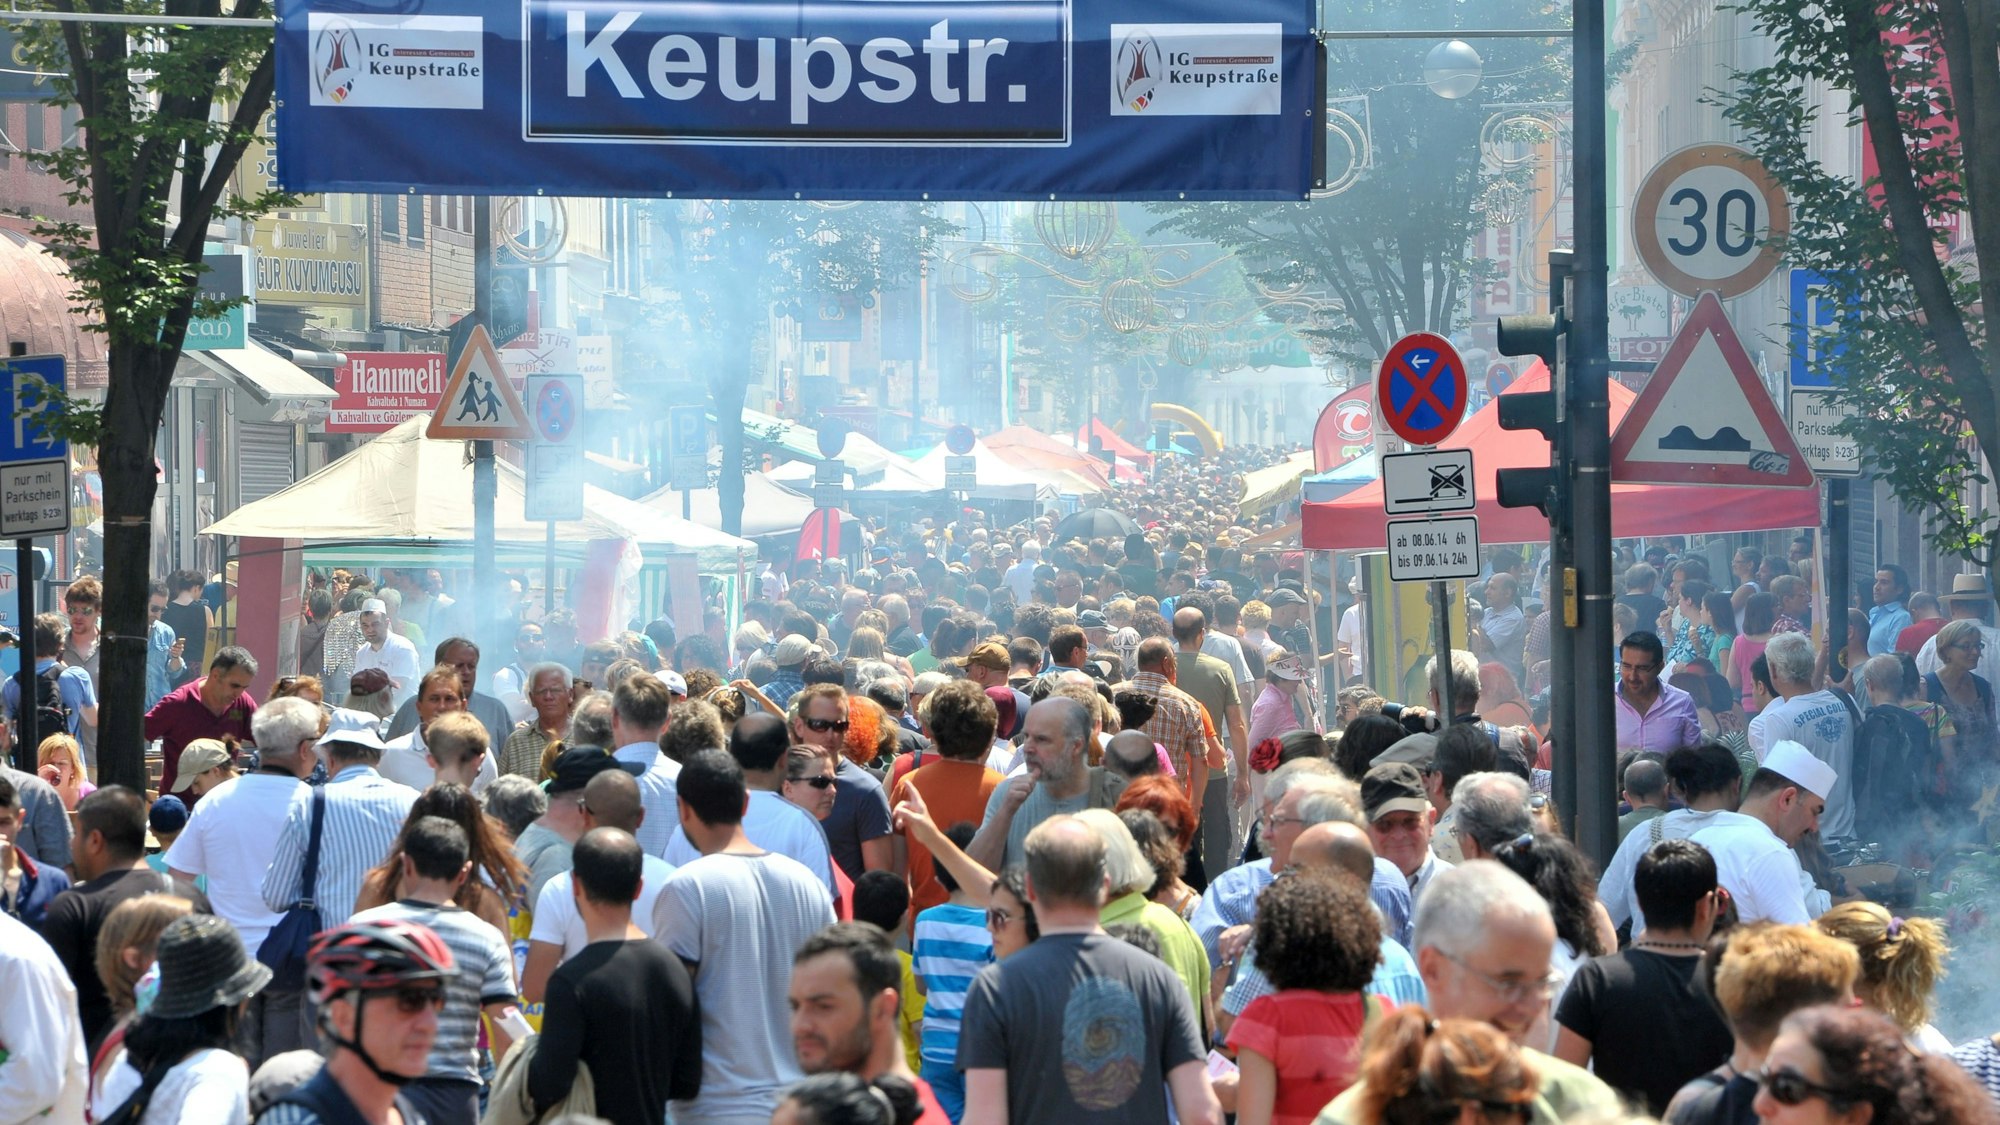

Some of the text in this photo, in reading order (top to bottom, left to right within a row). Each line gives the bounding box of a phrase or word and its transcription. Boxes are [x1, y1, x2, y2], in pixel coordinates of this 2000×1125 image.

[369, 43, 390, 57] IG
[565, 10, 1027, 125] Keupstr.
[1169, 53, 1190, 66] IG
[369, 61, 481, 80] Keupstraße
[1169, 68, 1279, 87] Keupstraße
[1667, 188, 1756, 257] 30
[283, 226, 326, 250] Juwelier
[285, 257, 362, 296] KUYUMCUSU
[1608, 286, 1667, 319] afe-Bistro
[1807, 284, 1846, 372] P
[1623, 340, 1671, 355] FOT
[352, 359, 442, 394] Hanımeli
[12, 372, 49, 448] P
[372, 415, 381, 423] ve
[1806, 403, 1845, 417] nur mit
[1799, 444, 1830, 461] erktags
[14, 472, 52, 486] nur mit
[6, 489, 61, 504] Parkschein
[4, 511, 39, 524] werktags
[1397, 531, 1467, 547] ab 08.06.14 6h
[1398, 552, 1468, 568] bis 09.06.14 24h
[1793, 706, 1827, 728] SPECIAL
